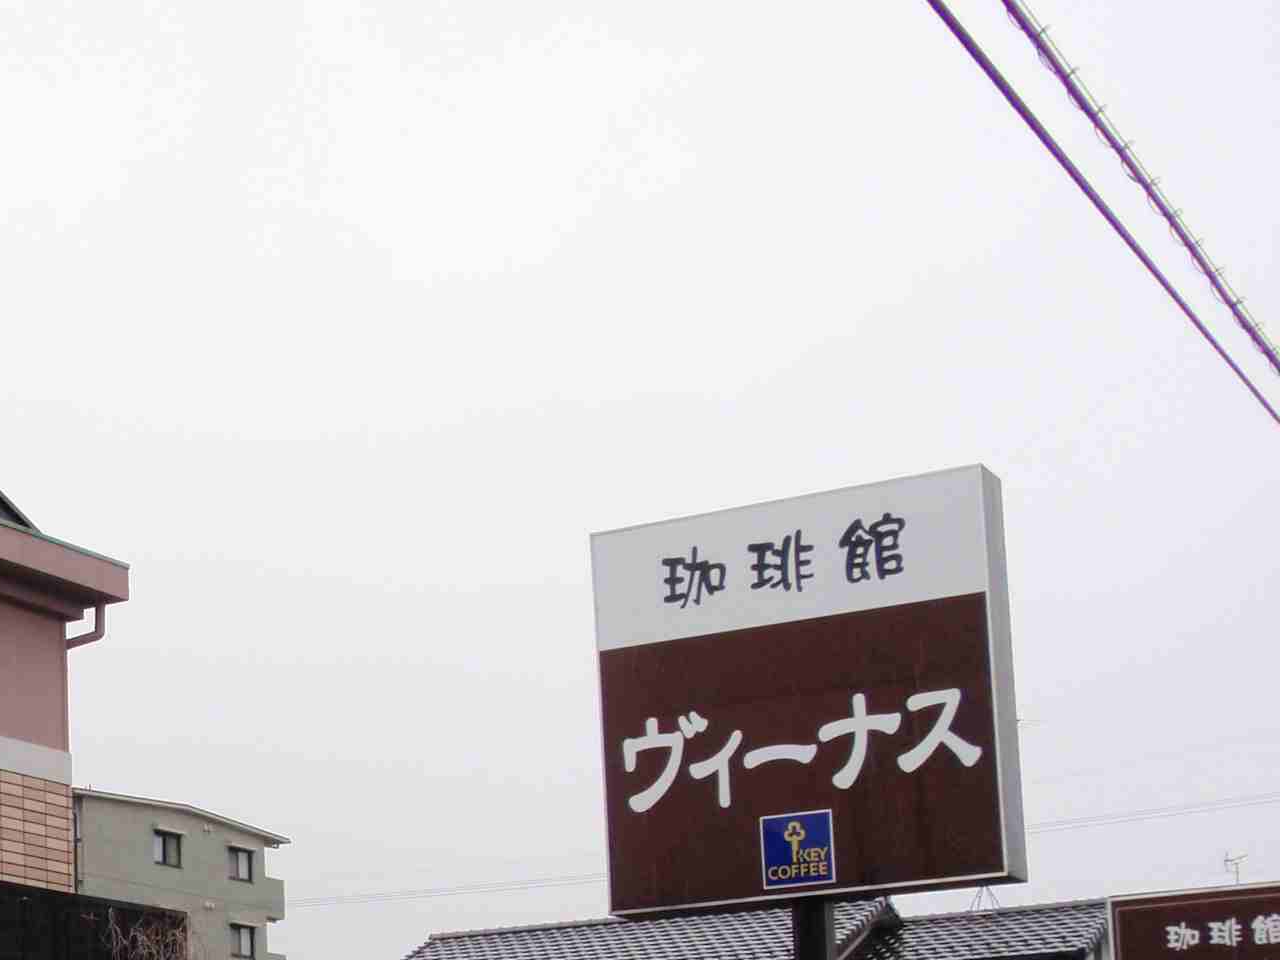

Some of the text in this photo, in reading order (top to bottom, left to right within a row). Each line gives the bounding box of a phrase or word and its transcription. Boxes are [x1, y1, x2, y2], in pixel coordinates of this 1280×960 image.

[662, 512, 906, 608] 珈琲館
[622, 688, 983, 813] ヴィーナス
[767, 862, 829, 880] COFFEE
[798, 846, 829, 862] KEY
